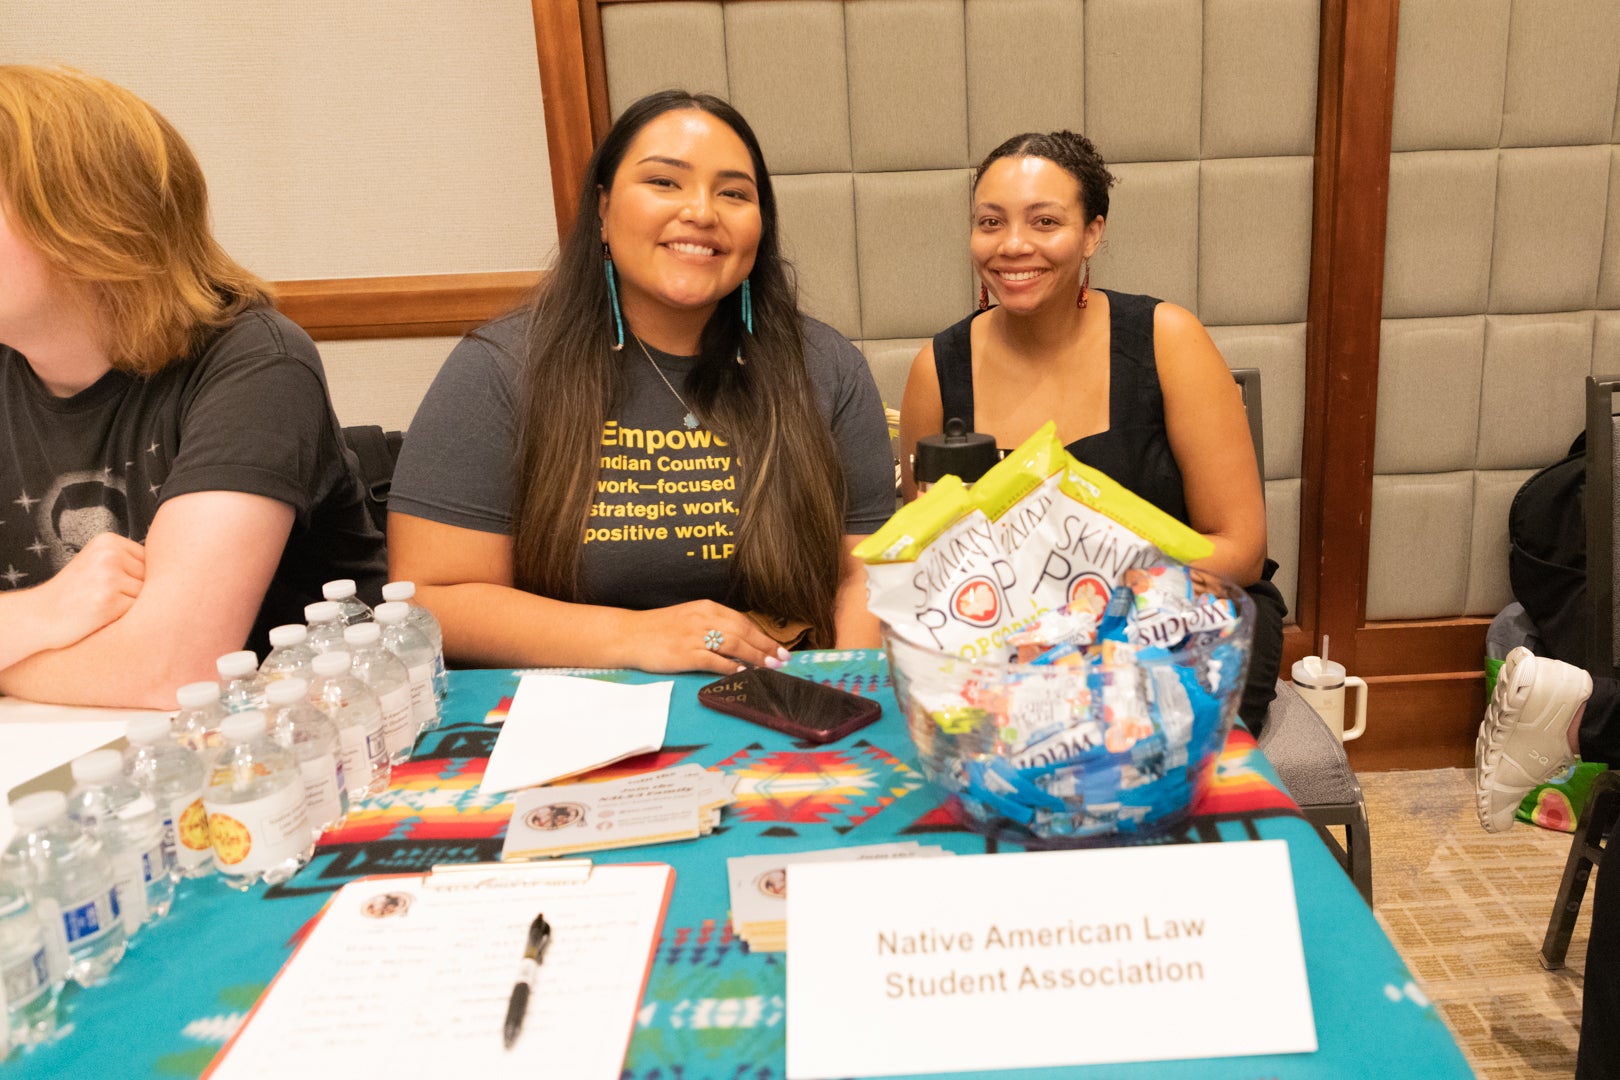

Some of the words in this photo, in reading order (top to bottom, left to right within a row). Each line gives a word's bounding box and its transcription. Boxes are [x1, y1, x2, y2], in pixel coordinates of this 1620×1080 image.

[600, 454, 652, 471] ndian
[656, 455, 731, 472] Country
[589, 501, 678, 520] strategic
[682, 498, 740, 517] work,
[583, 524, 669, 544] positive
[674, 521, 734, 539] work.
[702, 543, 736, 560] ILP
[877, 928, 975, 957] Native
[984, 918, 1132, 950] American
[1144, 914, 1206, 942] Law
[885, 968, 1008, 999] Student
[1018, 957, 1206, 991] Association
